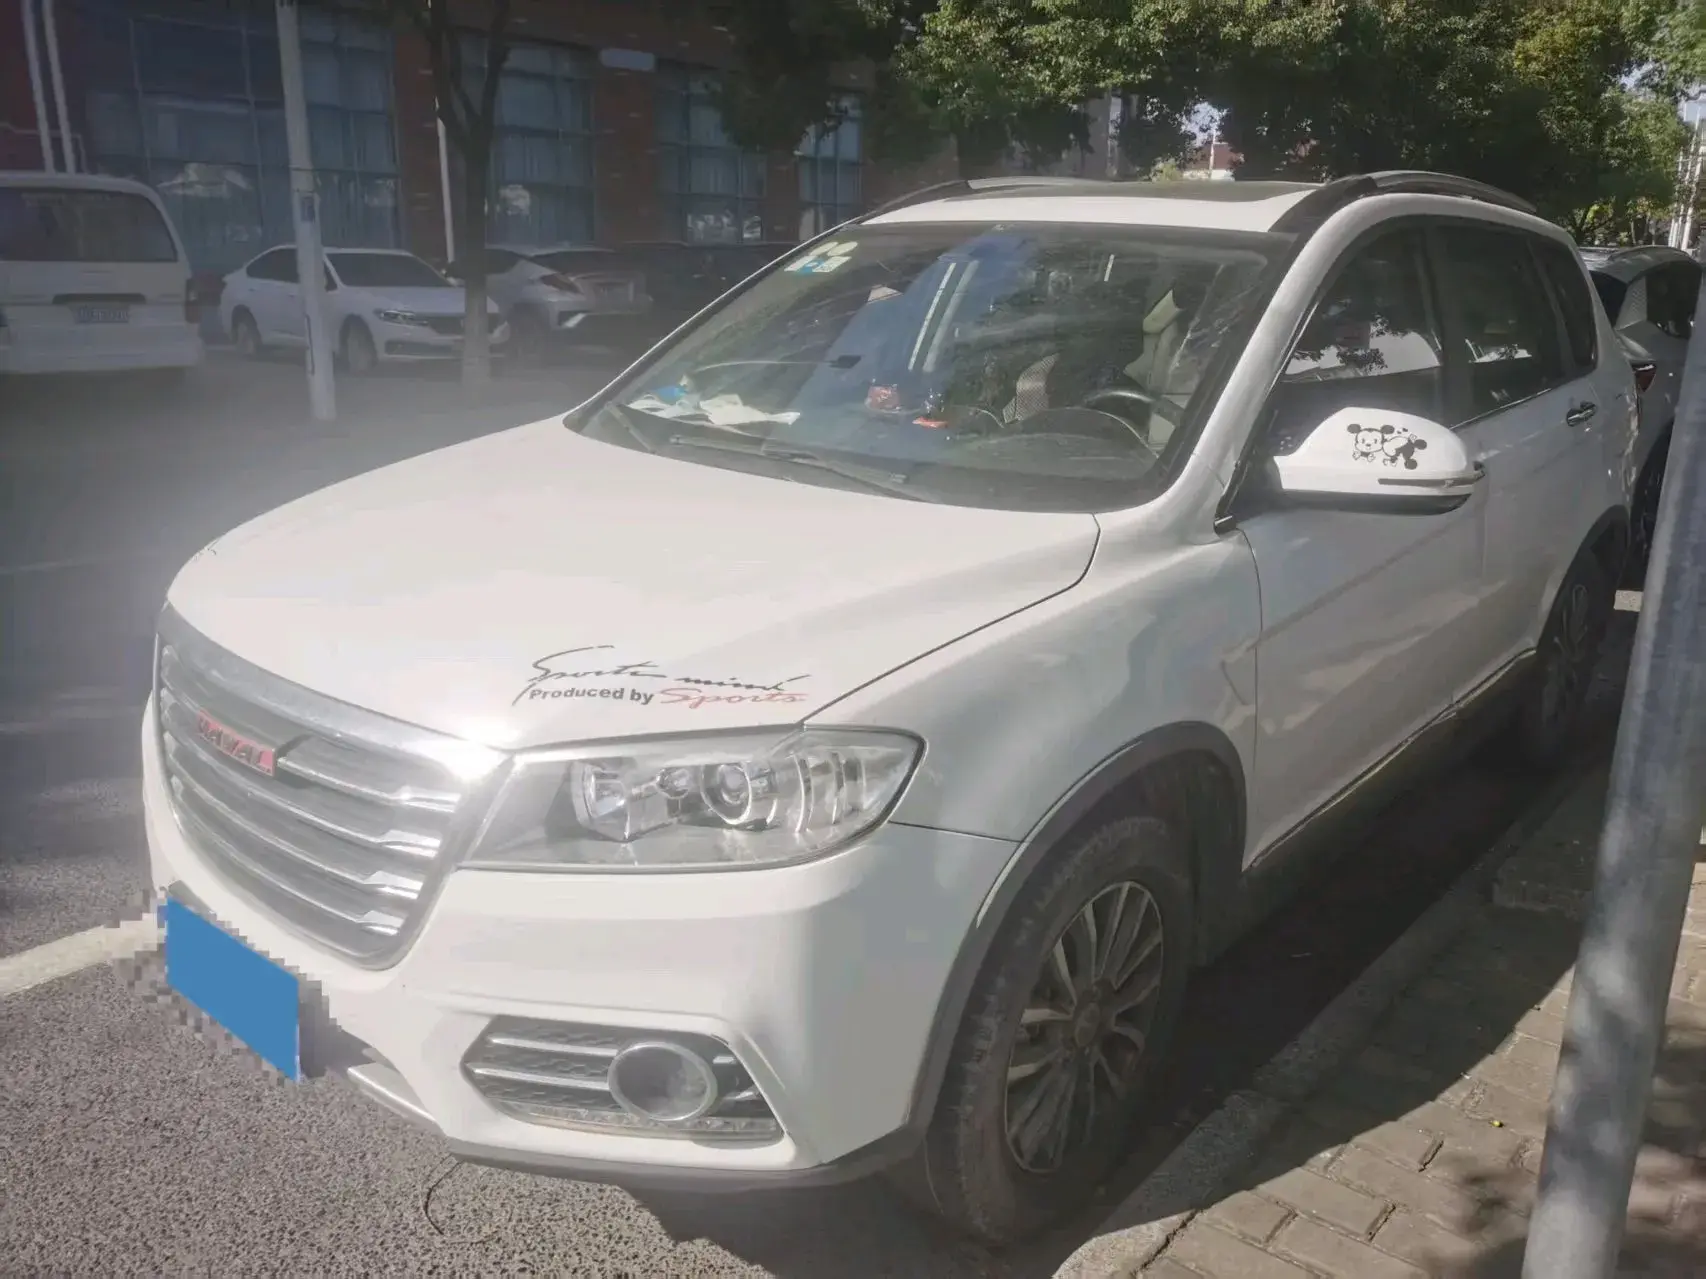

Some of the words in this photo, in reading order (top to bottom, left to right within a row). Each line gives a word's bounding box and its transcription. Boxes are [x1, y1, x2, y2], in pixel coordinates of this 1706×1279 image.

[528, 687, 625, 700] Produced
[629, 688, 655, 706] by
[657, 687, 809, 709] Sports
[198, 710, 274, 775] HAVAL
